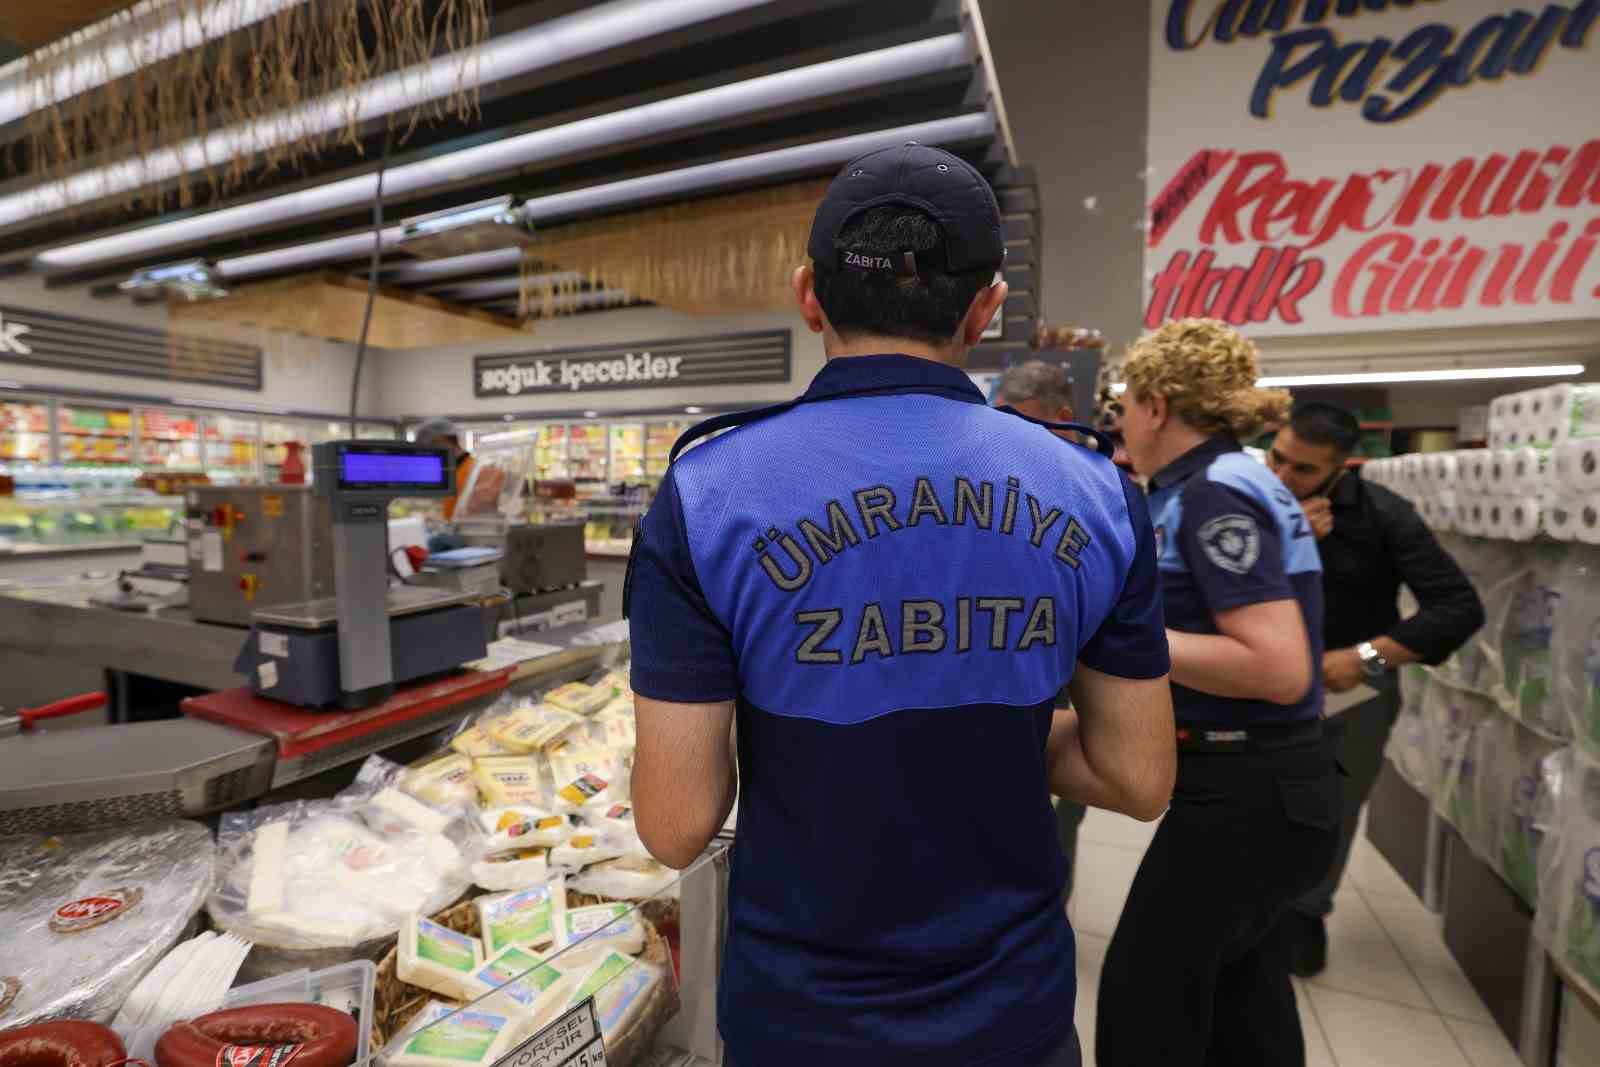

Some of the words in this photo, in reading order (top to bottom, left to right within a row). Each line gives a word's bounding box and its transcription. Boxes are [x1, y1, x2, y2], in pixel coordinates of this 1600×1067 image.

[844, 251, 893, 270] ZABITA
[1145, 246, 1325, 329] Halk
[481, 359, 551, 395] soğuk
[560, 352, 683, 391] içecekler
[752, 473, 1092, 593] ÜMRANİYE
[794, 596, 1057, 666] ZABITA
